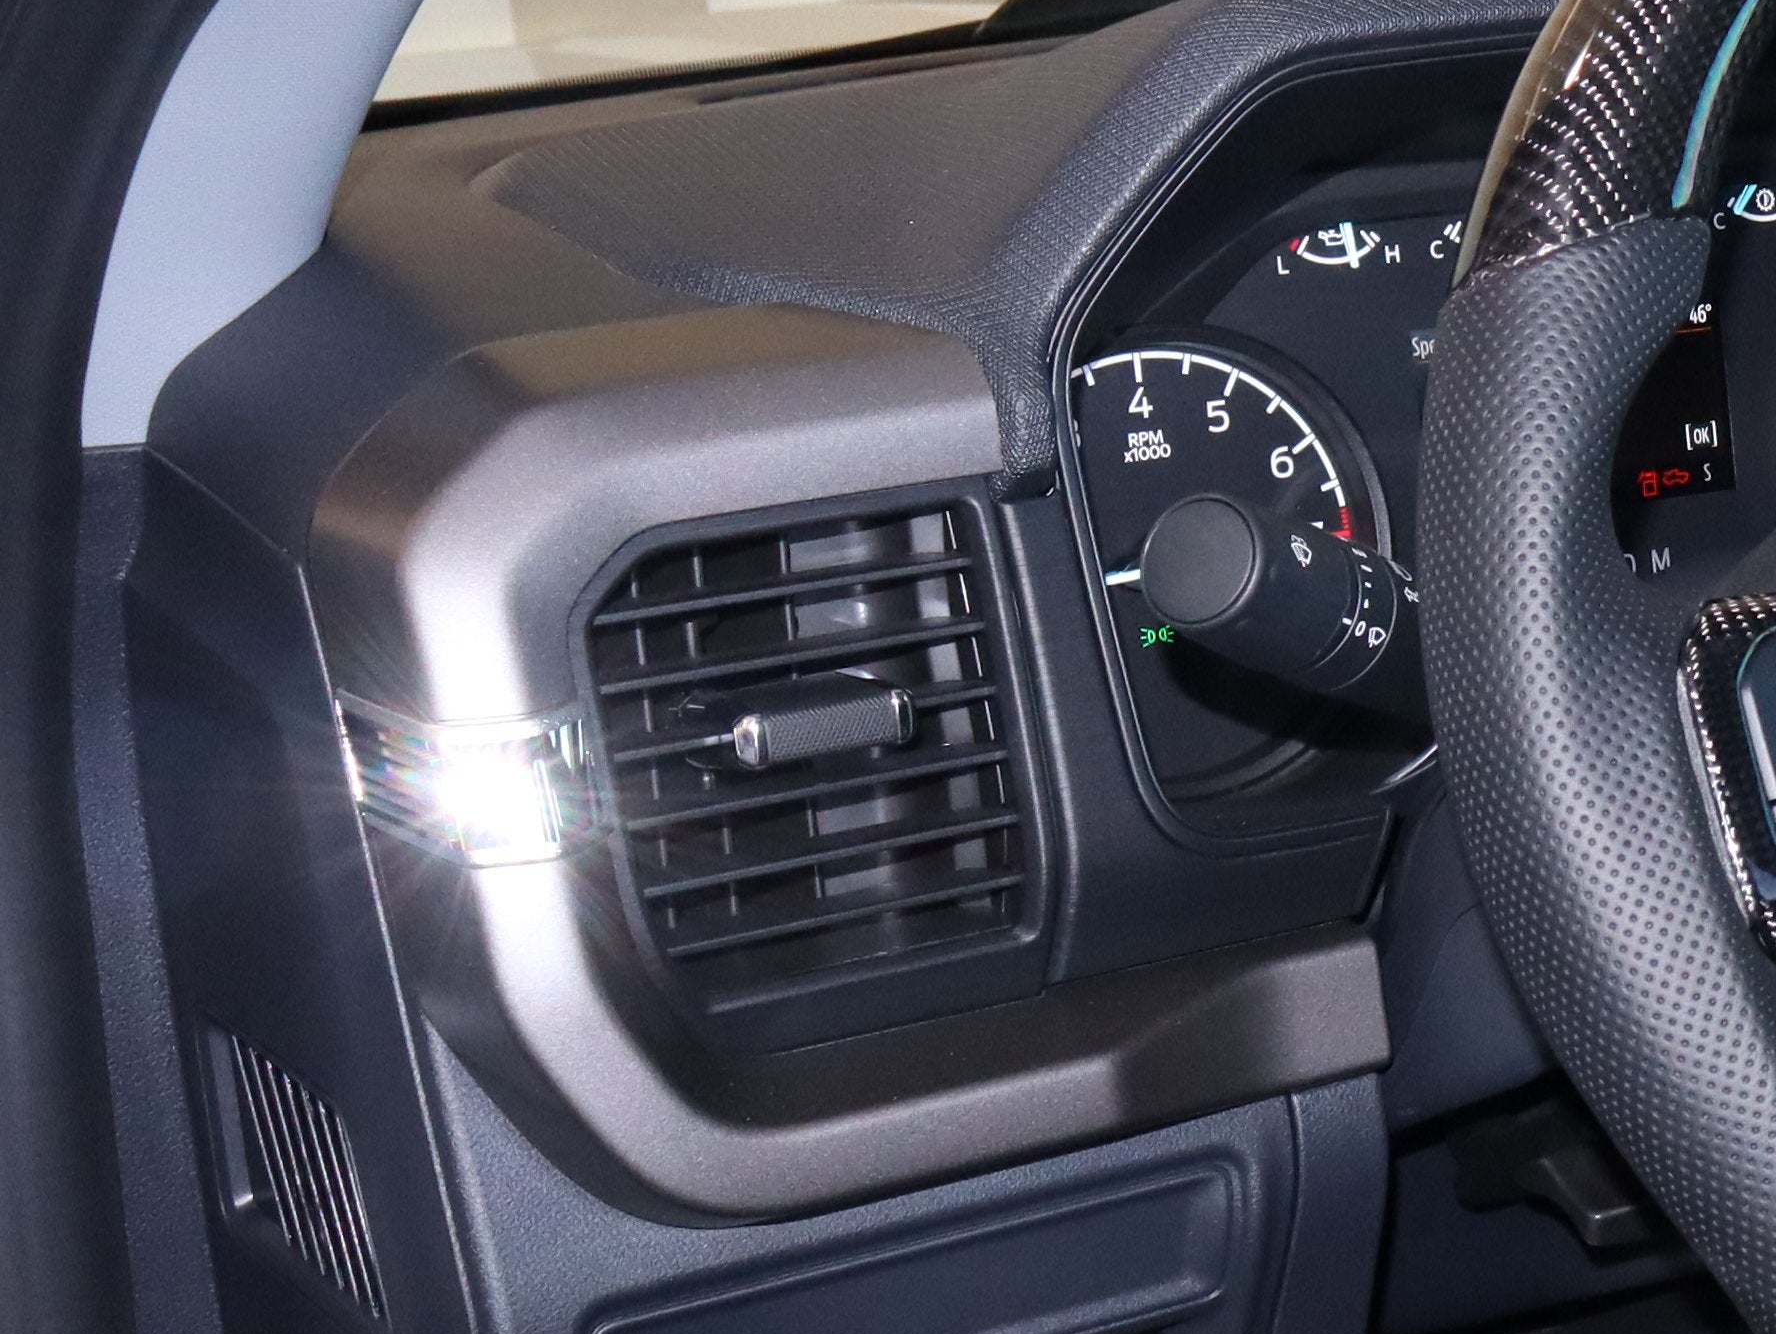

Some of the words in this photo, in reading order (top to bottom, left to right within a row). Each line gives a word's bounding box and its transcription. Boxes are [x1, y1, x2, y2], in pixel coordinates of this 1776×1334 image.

[1384, 244, 1401, 264] H
[1429, 239, 1445, 260] C
[1276, 255, 1290, 276] L
[1127, 385, 1154, 419] 4
[1206, 399, 1231, 433] 5
[1127, 429, 1165, 449] RPM
[1123, 443, 1172, 463] x1000
[1269, 445, 1295, 479] 6
